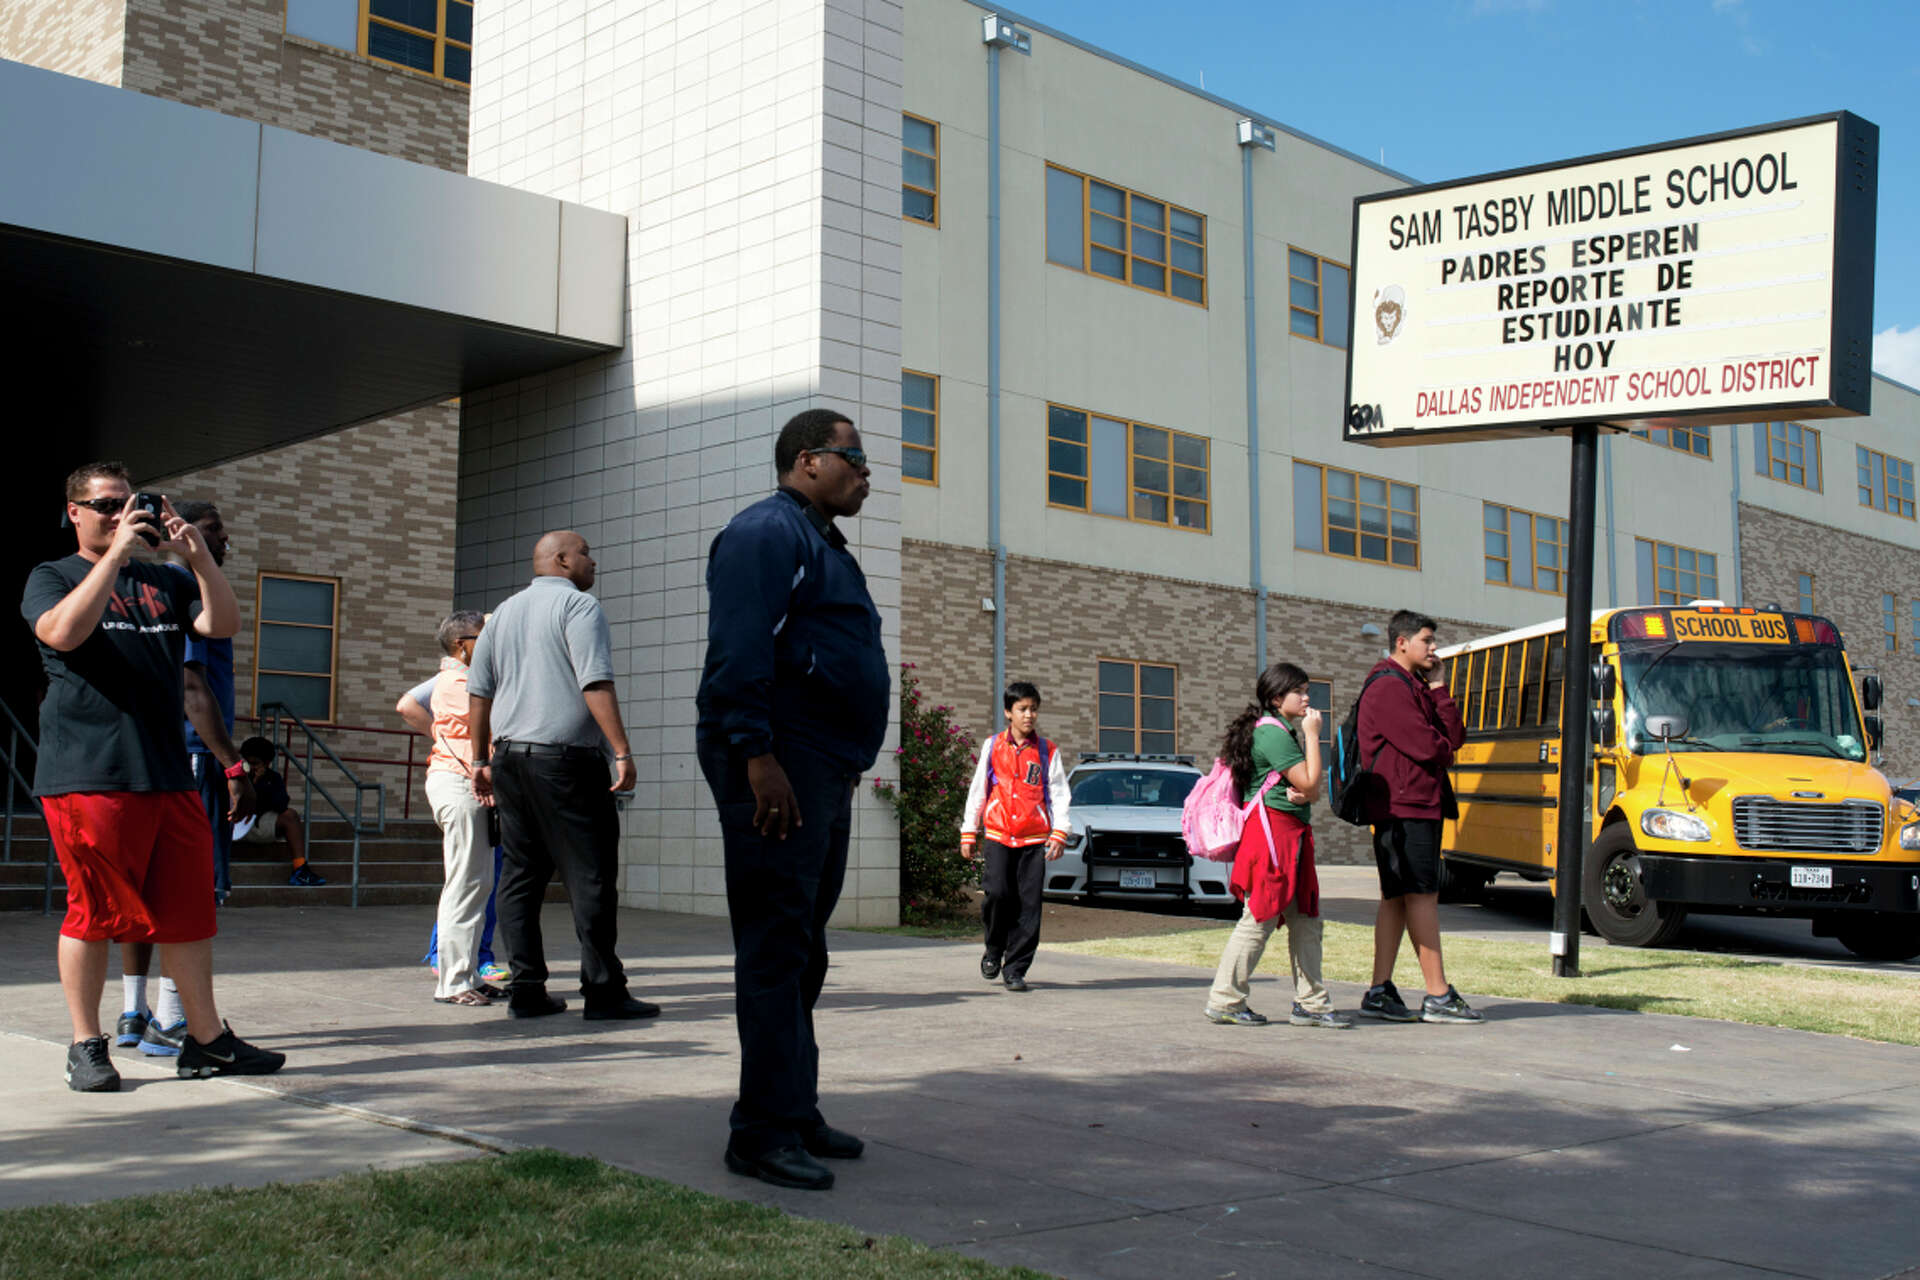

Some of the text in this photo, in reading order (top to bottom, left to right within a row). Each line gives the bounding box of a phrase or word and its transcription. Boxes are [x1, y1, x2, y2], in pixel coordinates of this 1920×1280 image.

[1389, 152, 1797, 250] SAM TASBY MIDDLE SCHOOL
[1442, 223, 1698, 285] PADRES ESPEREN
[1498, 260, 1693, 311] REPORTE DE
[1502, 298, 1681, 344] ESTUDIANTE
[1554, 340, 1615, 372] HOY
[1416, 387, 1482, 418] DALLAS
[1489, 375, 1619, 411] INDEPENDENT
[1626, 367, 1711, 401] SCHOOL
[1721, 356, 1819, 393] DISTRICT
[1675, 617, 1787, 639] SCHOOL BUS
[1024, 761, 1041, 786] B
